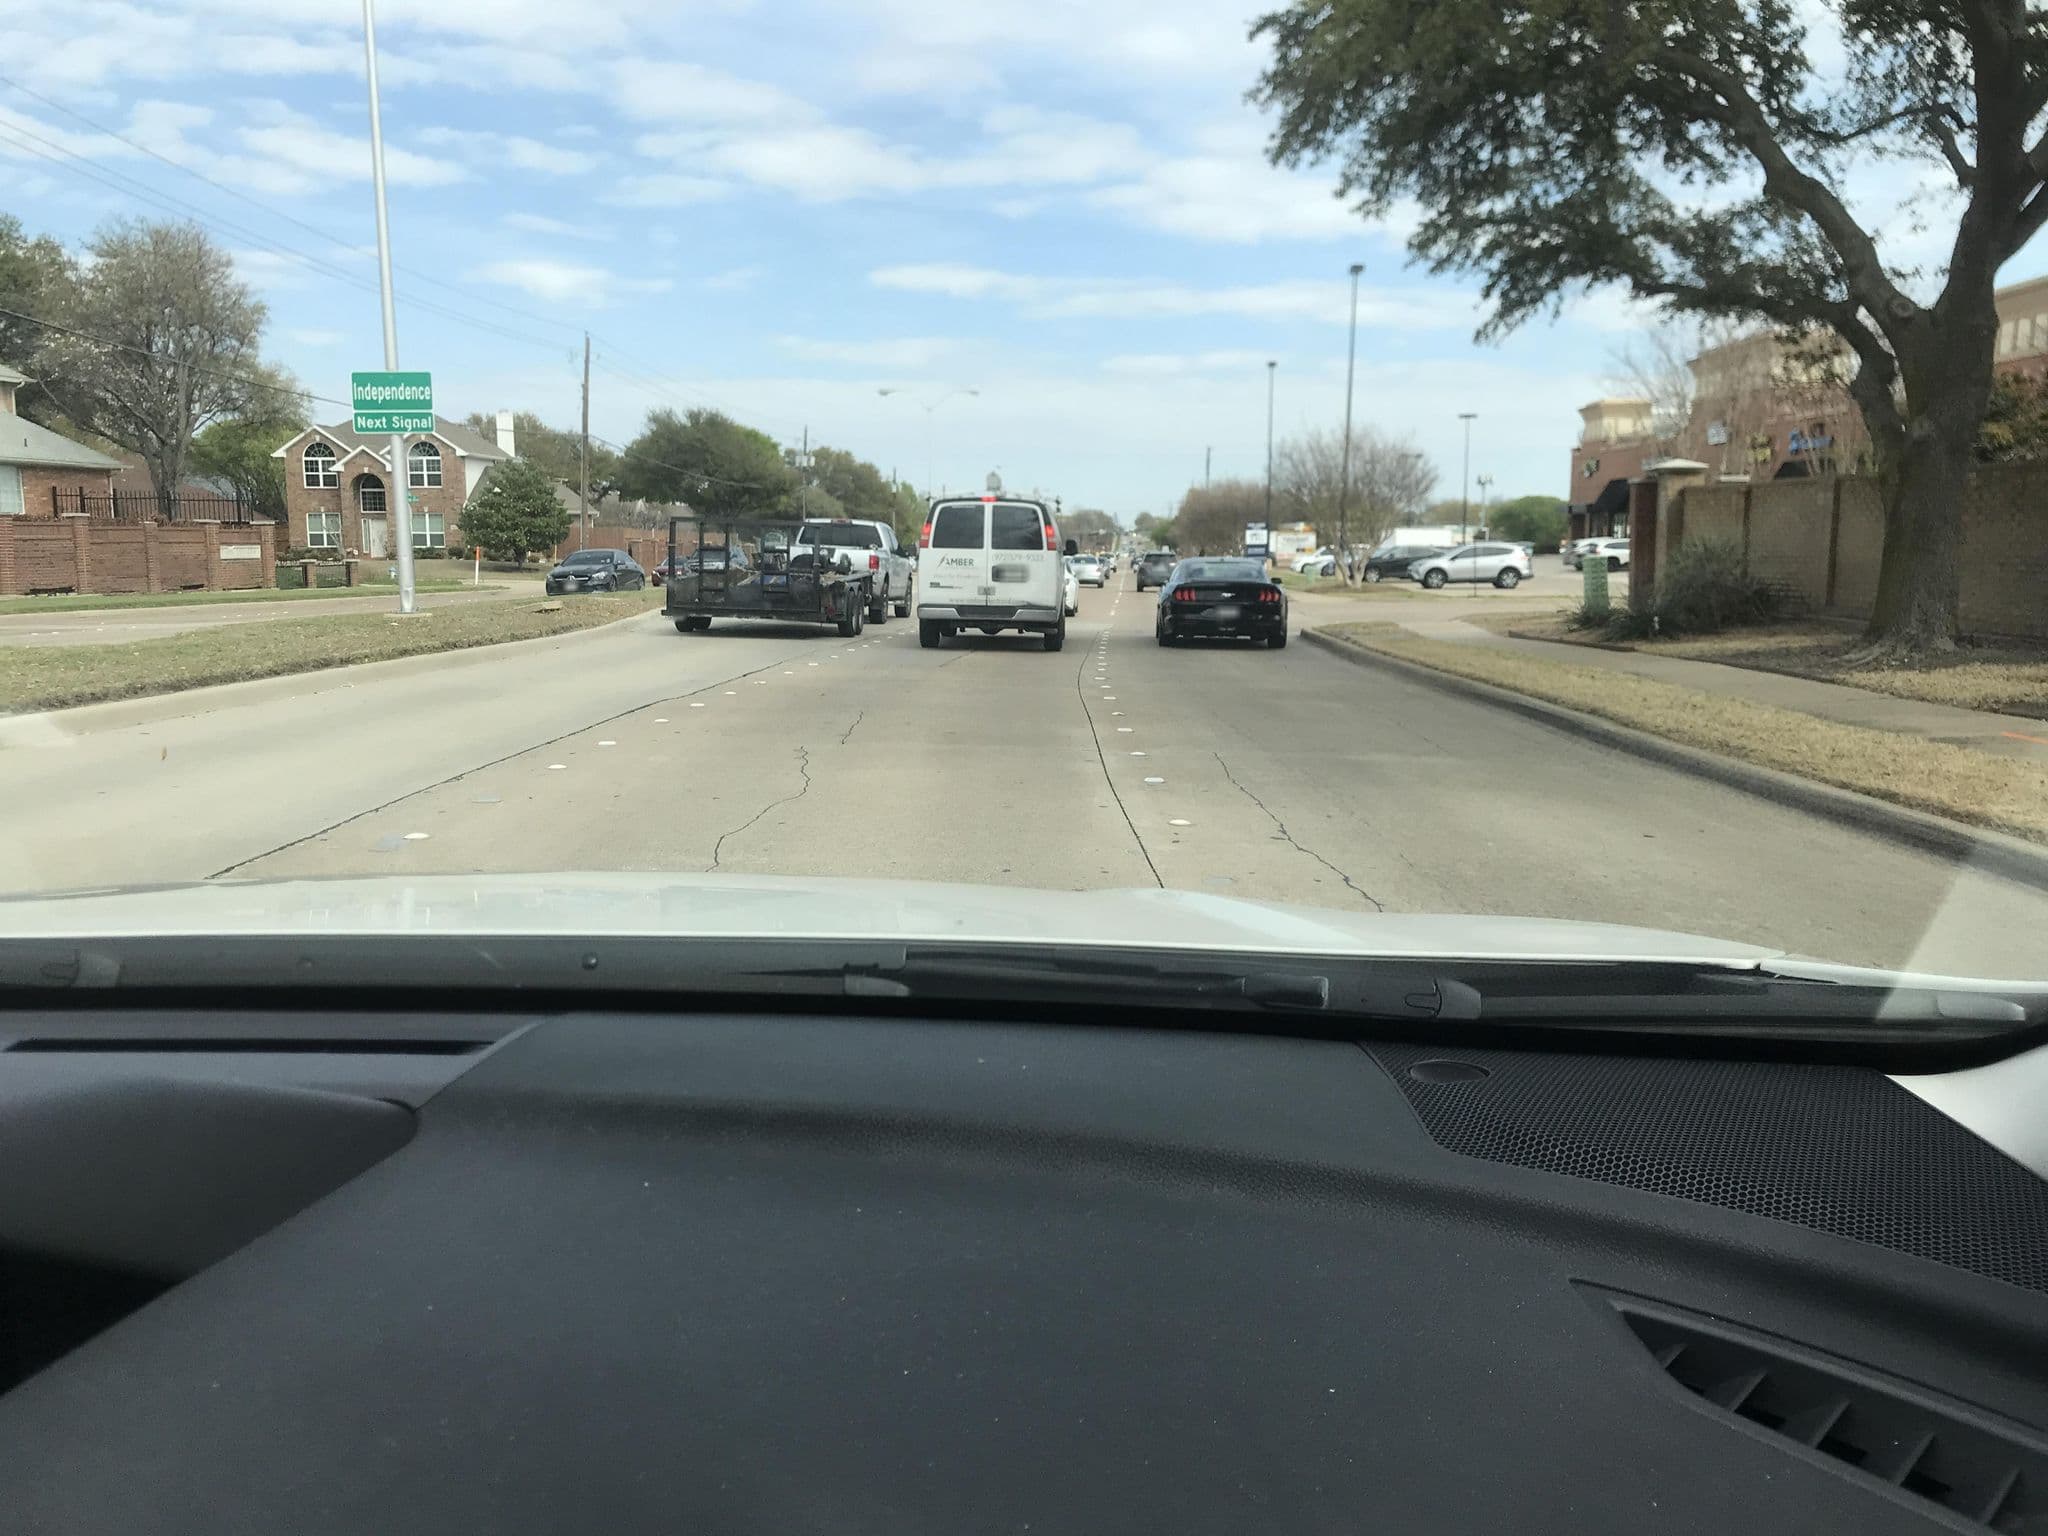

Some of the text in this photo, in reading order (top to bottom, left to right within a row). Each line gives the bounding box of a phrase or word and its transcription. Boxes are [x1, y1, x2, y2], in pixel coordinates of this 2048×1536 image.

[353, 382, 431, 404] Independence
[357, 416, 432, 432] Next Signal
[939, 556, 974, 567] AMBER
